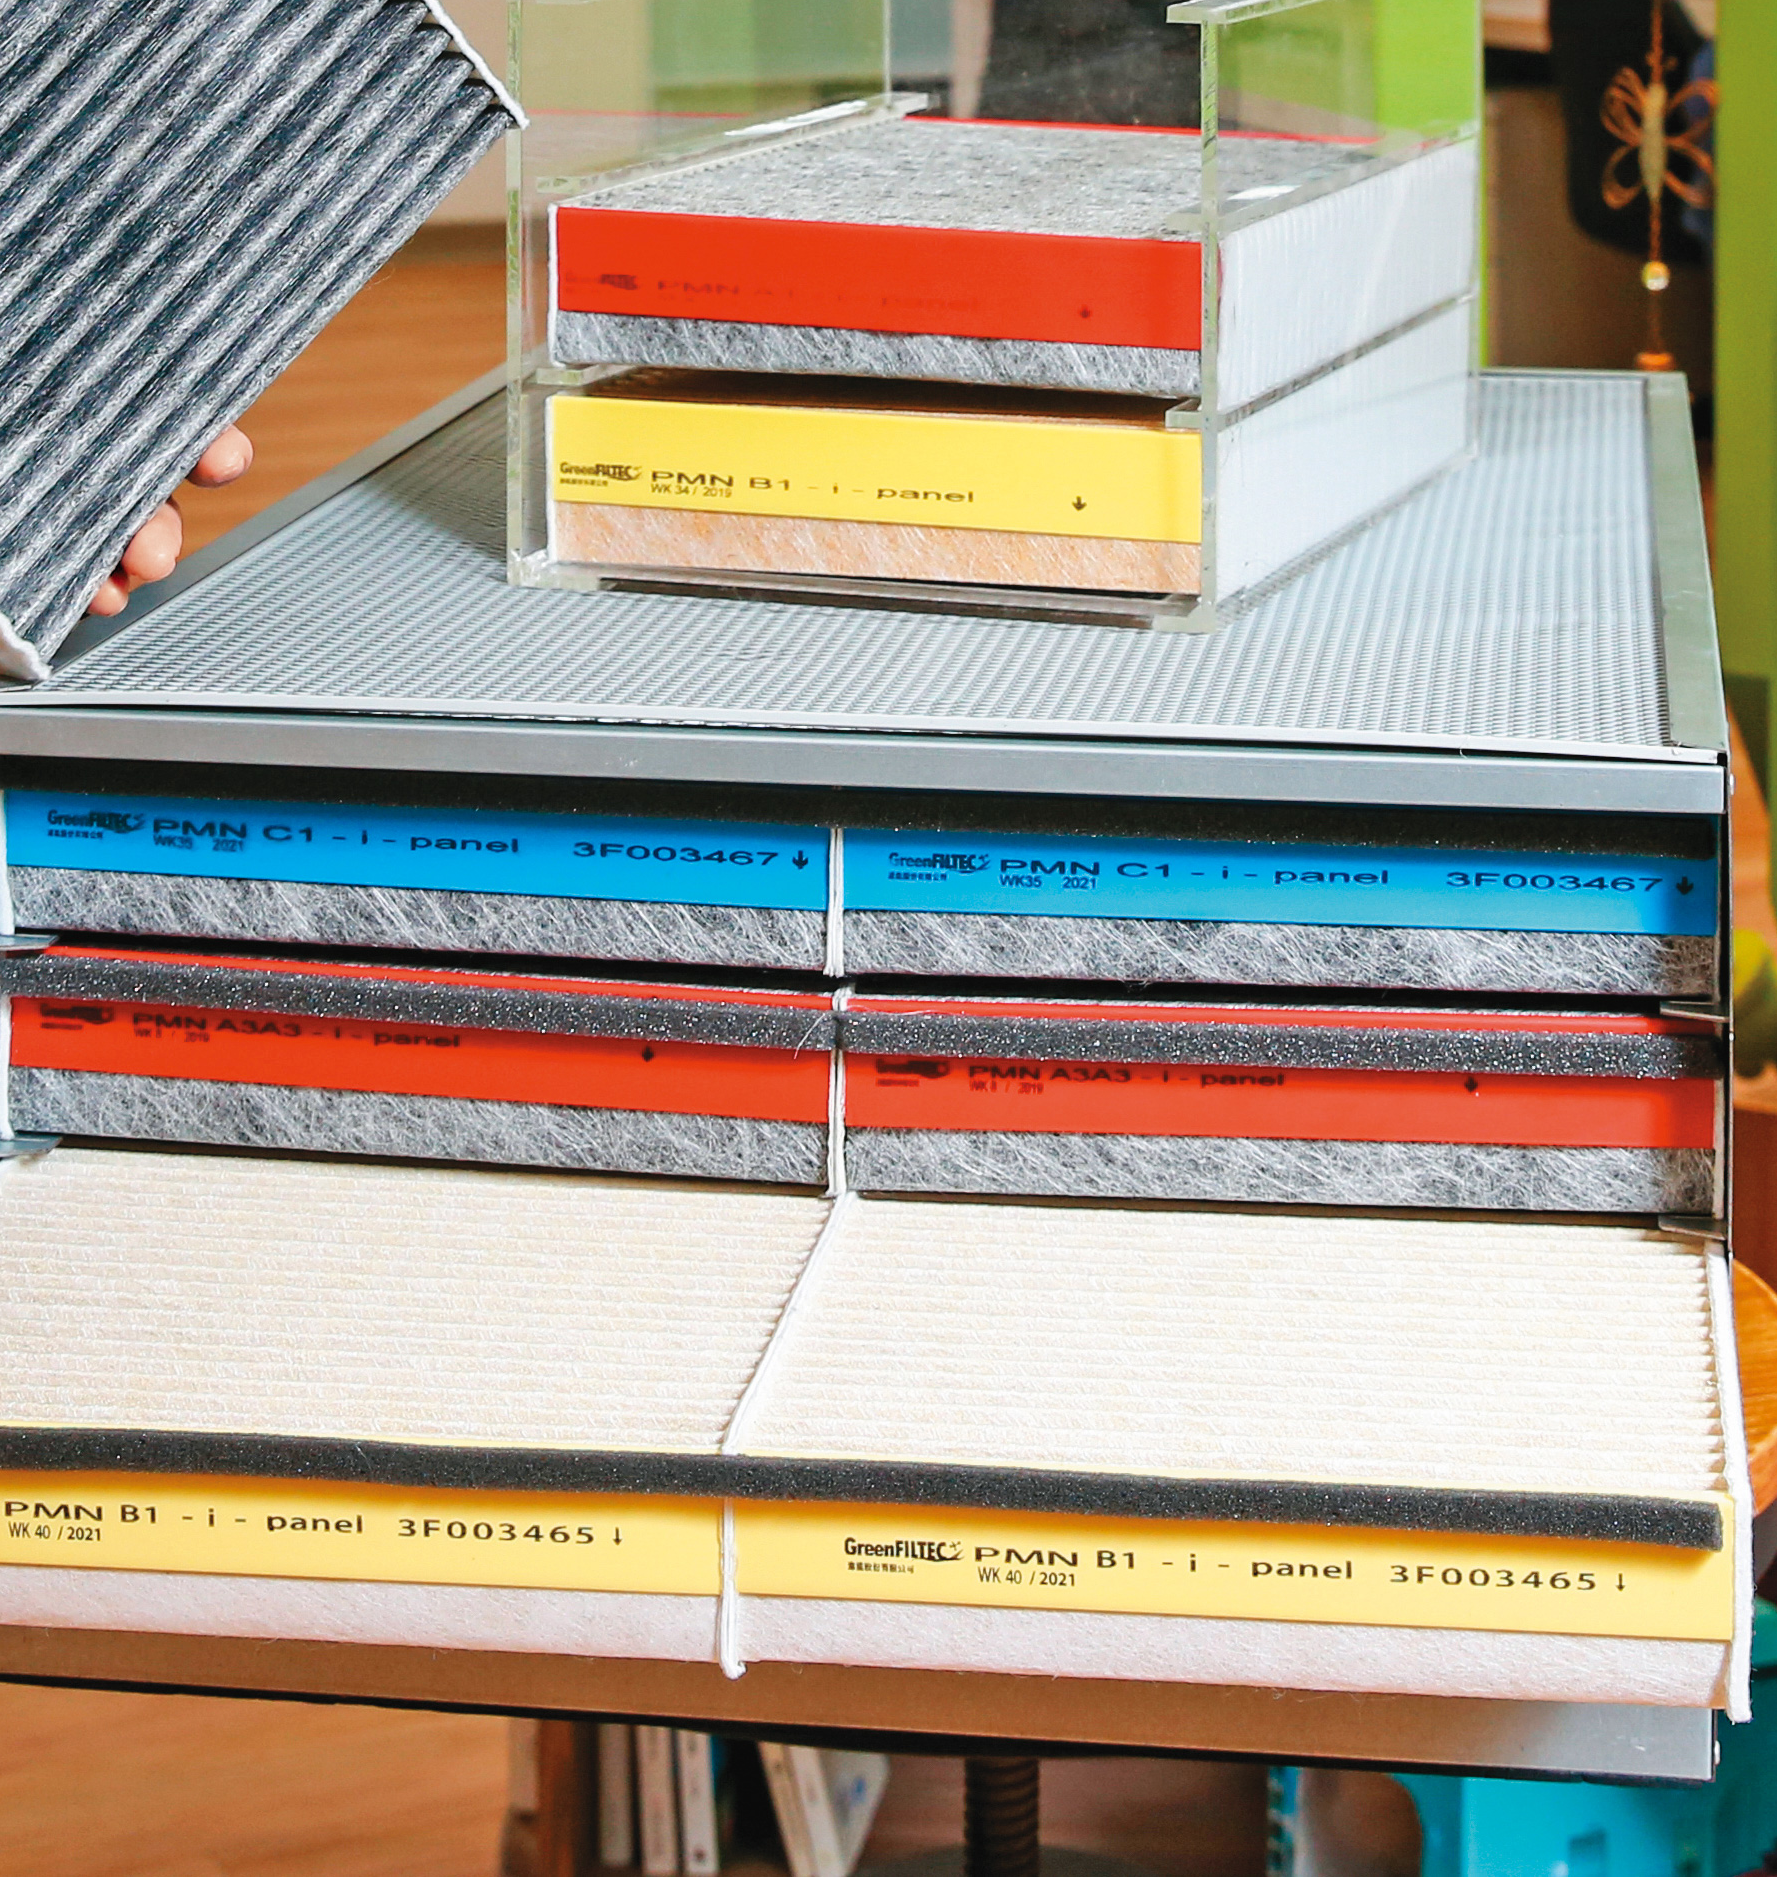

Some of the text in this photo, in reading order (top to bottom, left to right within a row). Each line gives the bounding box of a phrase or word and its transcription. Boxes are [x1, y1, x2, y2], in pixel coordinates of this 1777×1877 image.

[651, 471, 734, 487] PMN
[749, 477, 789, 491] B1
[877, 488, 974, 502] panel
[651, 484, 671, 494] WK
[703, 487, 732, 498] 2019
[153, 834, 193, 849] WK35
[153, 819, 247, 838] PMN
[263, 825, 312, 842] C1
[410, 836, 519, 853] panel
[573, 842, 778, 866] 3F003467
[888, 852, 976, 871] GreenFILTEC
[1000, 859, 1100, 875] PMN
[1117, 862, 1169, 878] C1
[1222, 866, 1228, 879] i
[1274, 870, 1388, 884] panel
[1446, 872, 1663, 892] 3F003467
[1000, 874, 1096, 890] WK35 2021
[132, 1013, 206, 1030] PMN
[374, 1033, 460, 1047] panel
[969, 1066, 1040, 1080] PMN
[1201, 1074, 1284, 1088] panel
[5, 1501, 102, 1522] PMN
[120, 1504, 156, 1523] B1
[208, 1508, 215, 1527] i
[267, 1514, 363, 1534] panel
[398, 1519, 594, 1544] 3F003465
[8, 1522, 31, 1539] WK
[35, 1525, 51, 1539] 40
[67, 1527, 101, 1541] 2021
[844, 1537, 946, 1560] GreenFILTEC
[975, 1546, 1078, 1567] PMN
[1096, 1550, 1135, 1569] B1
[1190, 1553, 1196, 1572] i
[1252, 1560, 1352, 1579] panel
[1390, 1565, 1596, 1590] 3F003465
[978, 1567, 1000, 1583] WK
[1005, 1570, 1022, 1584] 40
[1040, 1572, 1075, 1586] 2021
